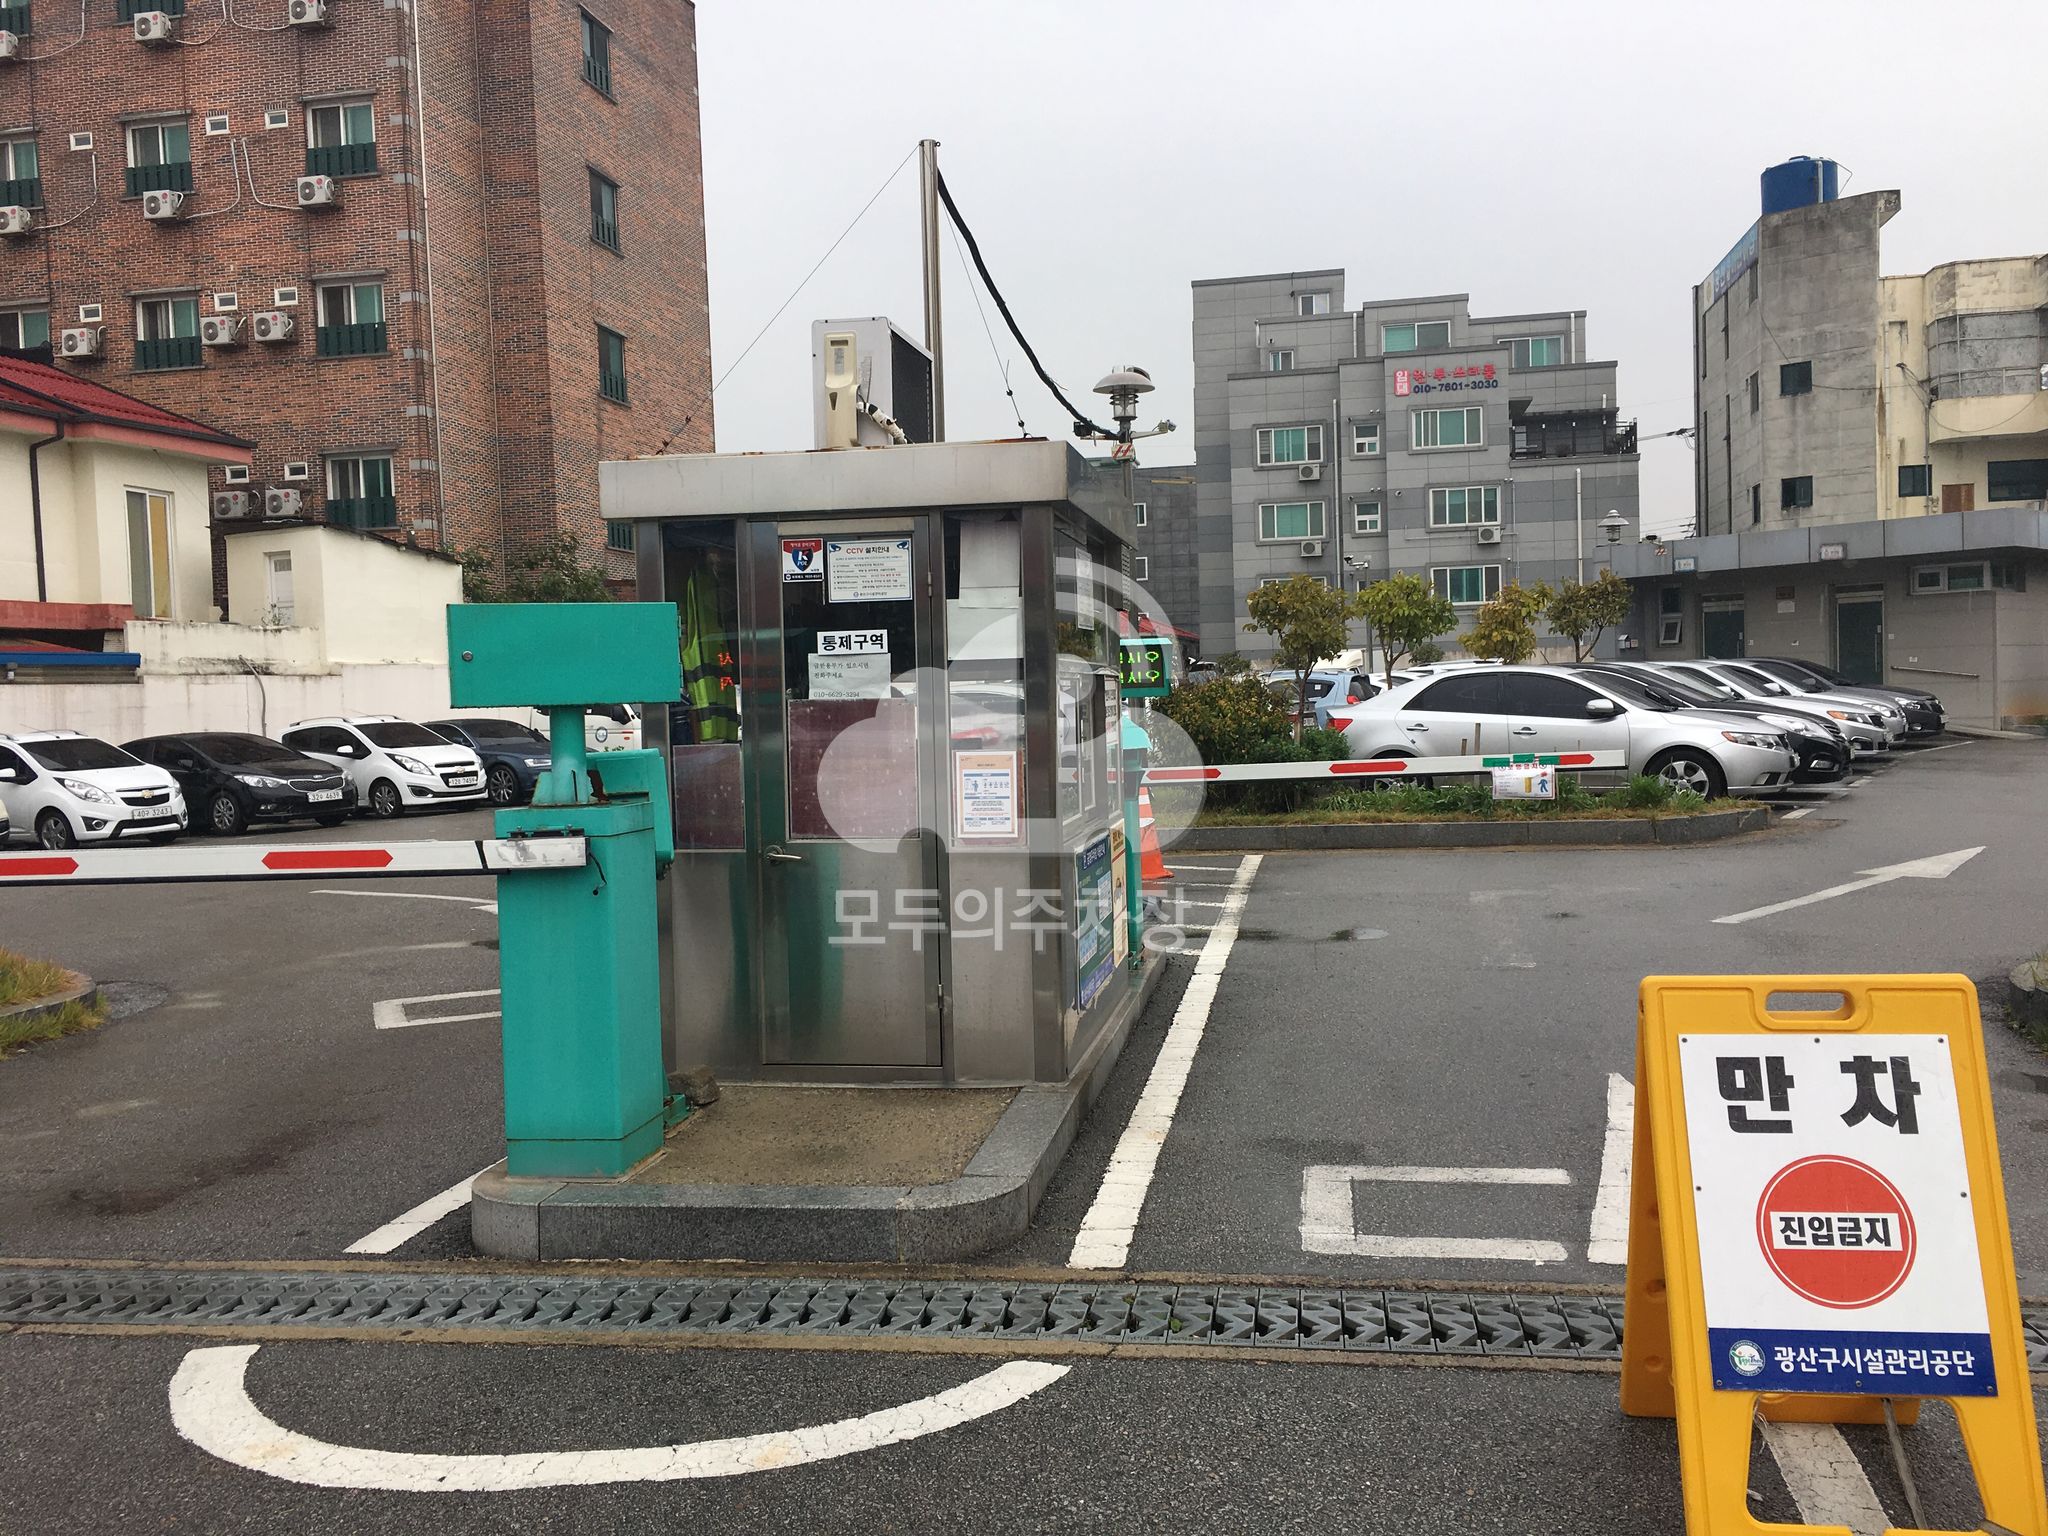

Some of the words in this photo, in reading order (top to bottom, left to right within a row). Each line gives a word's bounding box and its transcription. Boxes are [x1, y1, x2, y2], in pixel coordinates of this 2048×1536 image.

[1413, 380, 1499, 394] 010-7601-3030
[846, 547, 864, 555] CCTV
[865, 546, 890, 554] 설치안내
[821, 633, 884, 651] 통제구역
[1716, 1055, 1795, 1134] 만
[1839, 1055, 1921, 1135] 차
[1779, 1215, 1893, 1247] 진입금지
[1773, 1346, 1975, 1377] 광산구시설관리공단
